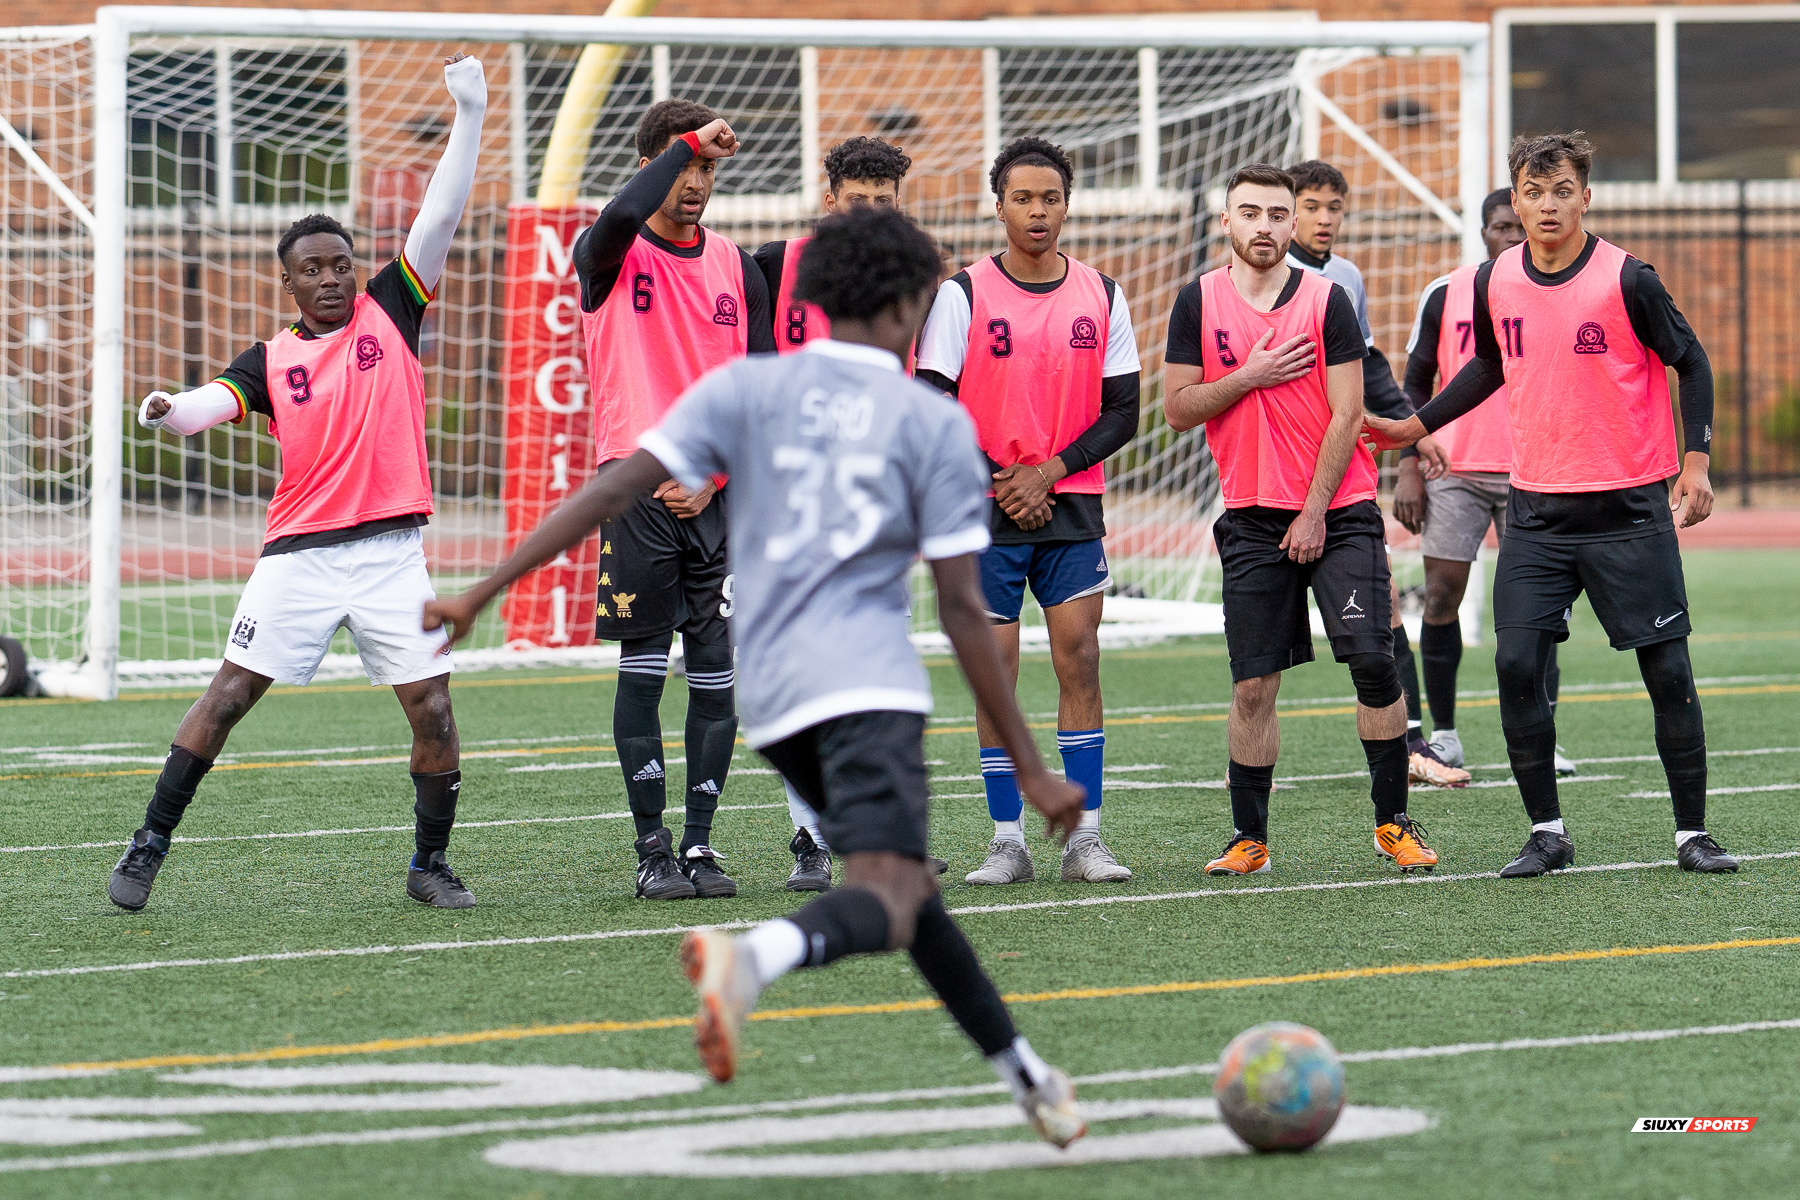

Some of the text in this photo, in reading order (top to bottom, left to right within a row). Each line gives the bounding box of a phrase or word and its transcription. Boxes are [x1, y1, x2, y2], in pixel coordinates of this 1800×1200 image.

[632, 272, 654, 314] 6
[786, 302, 808, 346] 8
[987, 318, 1013, 358] 3
[1071, 339, 1096, 347] QCSL
[1456, 321, 1472, 354] 7
[1501, 318, 1523, 357] 11
[1214, 329, 1238, 368] 5
[1576, 344, 1606, 352] QCSL
[286, 365, 313, 406] 9
[530, 225, 590, 644] McGil
[764, 446, 887, 562] 35
[632, 770, 665, 781] adidas
